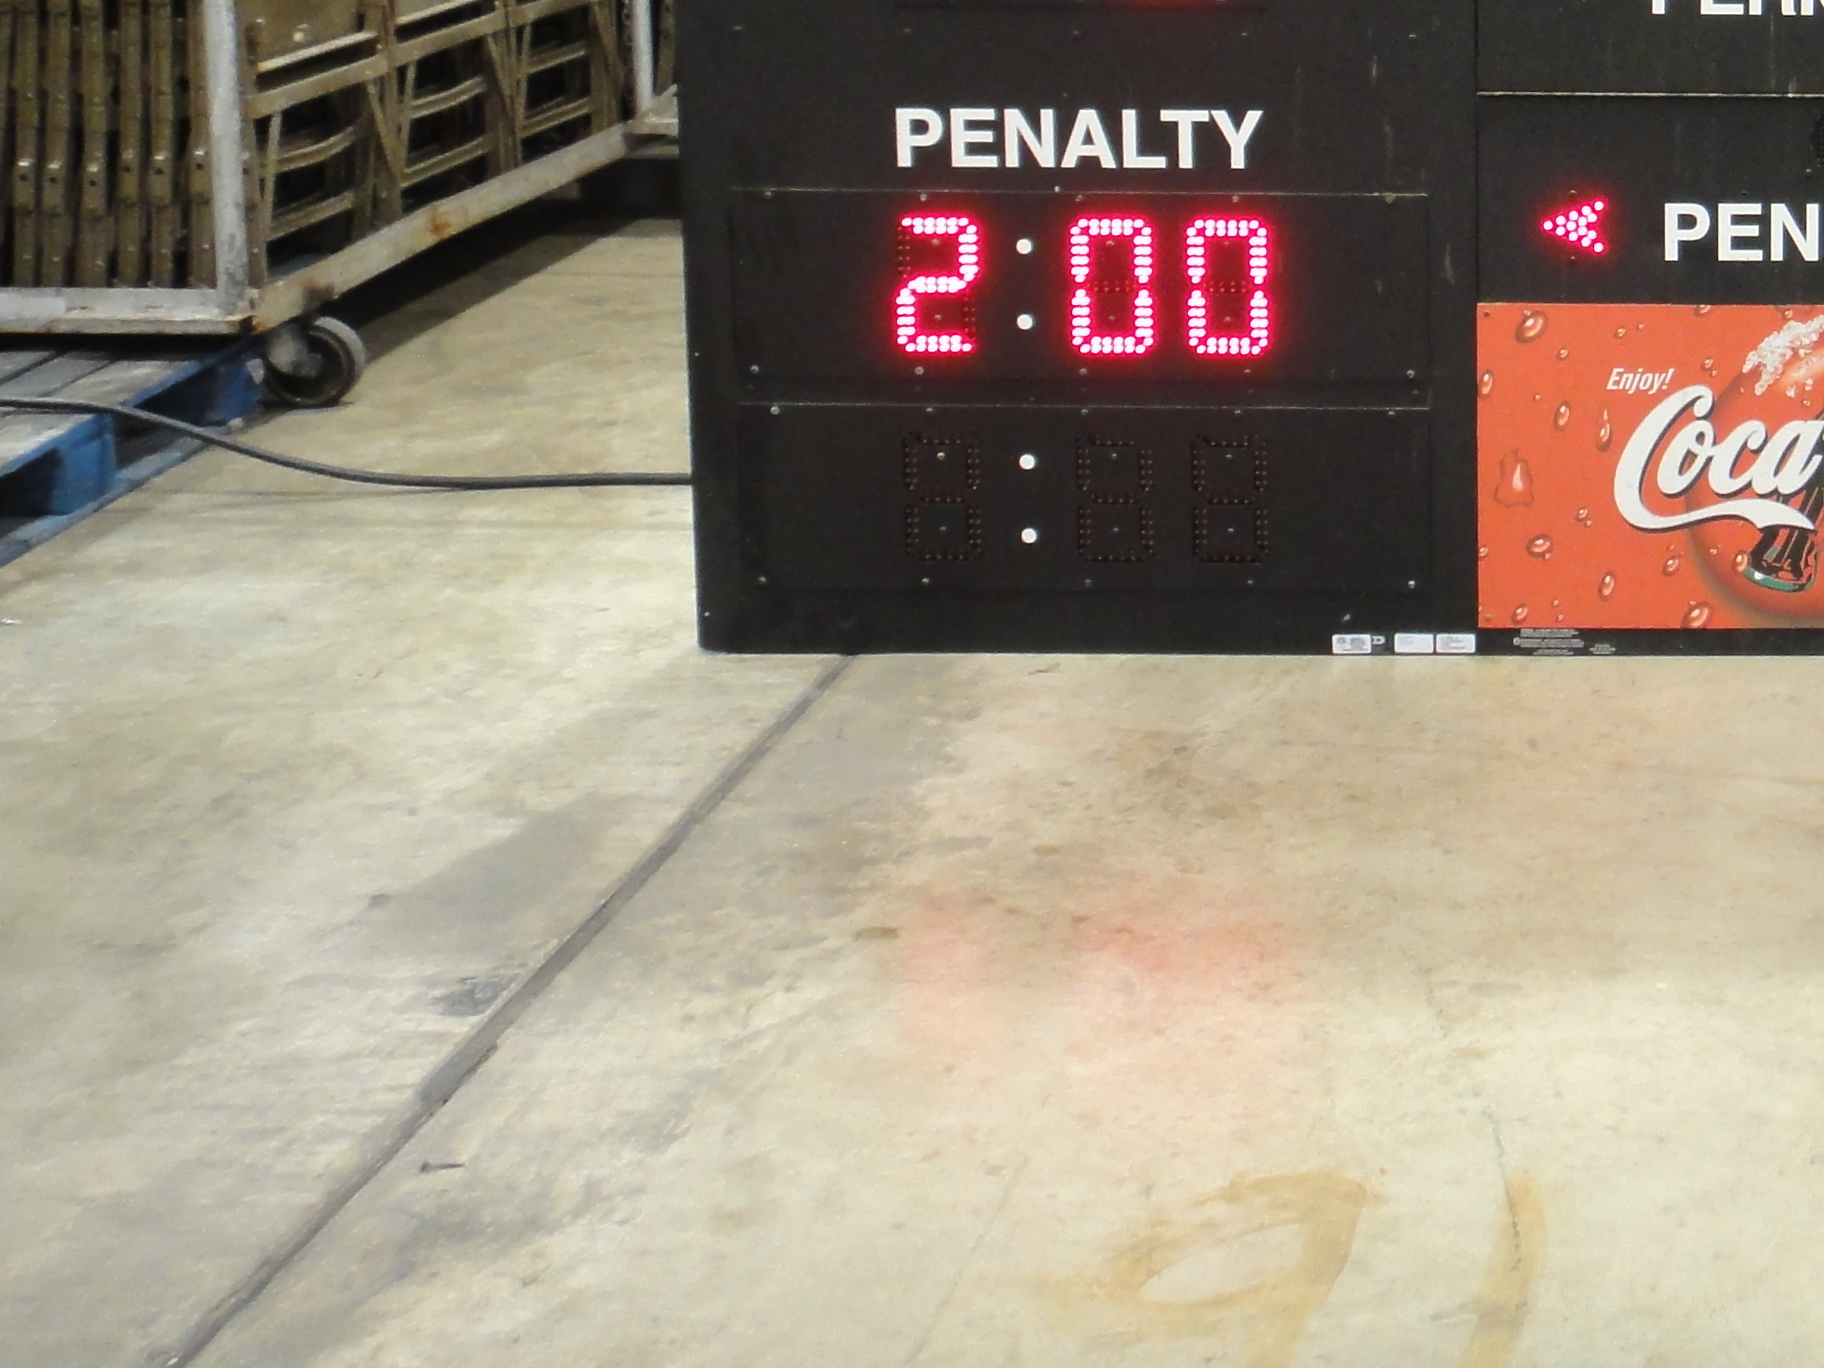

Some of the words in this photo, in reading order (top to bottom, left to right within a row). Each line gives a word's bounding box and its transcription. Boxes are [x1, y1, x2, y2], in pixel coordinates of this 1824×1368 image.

[895, 107, 1264, 170] PENALTY
[893, 213, 1273, 357] 2:00
[1605, 367, 1676, 396] Enjoy!
